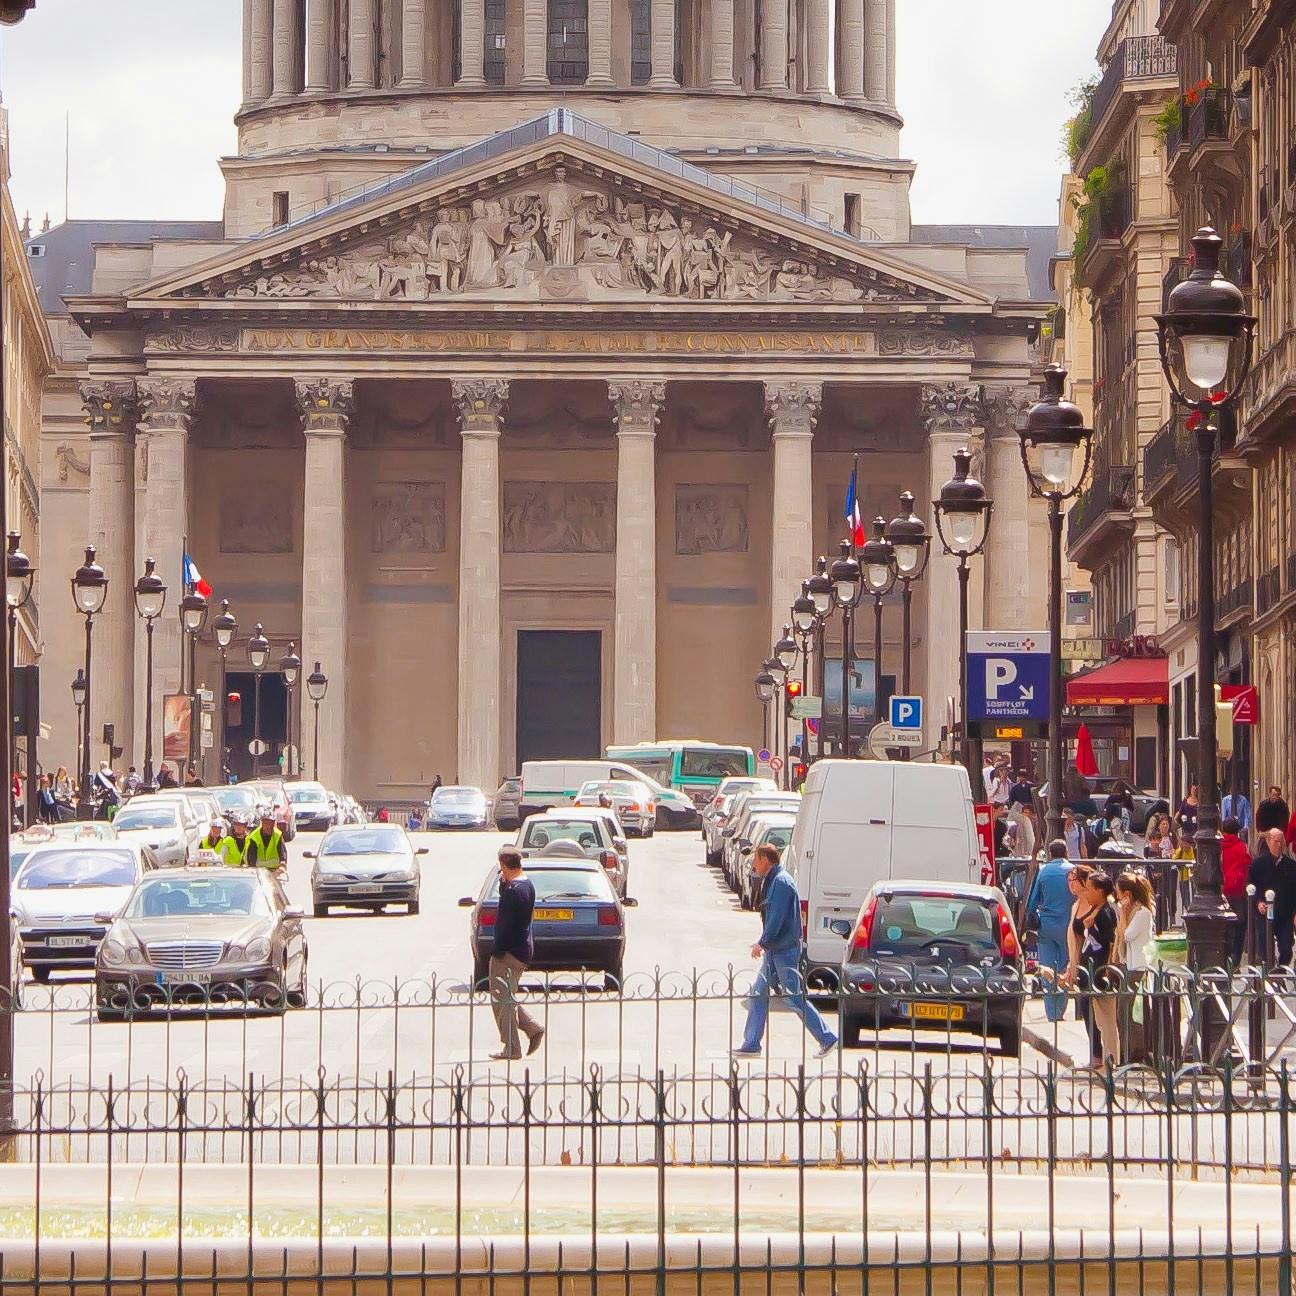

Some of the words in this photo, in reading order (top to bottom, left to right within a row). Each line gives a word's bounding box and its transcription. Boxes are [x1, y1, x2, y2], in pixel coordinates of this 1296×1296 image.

[304, 330, 404, 349] GRANDS
[985, 658, 1018, 700] P
[898, 702, 913, 723] P
